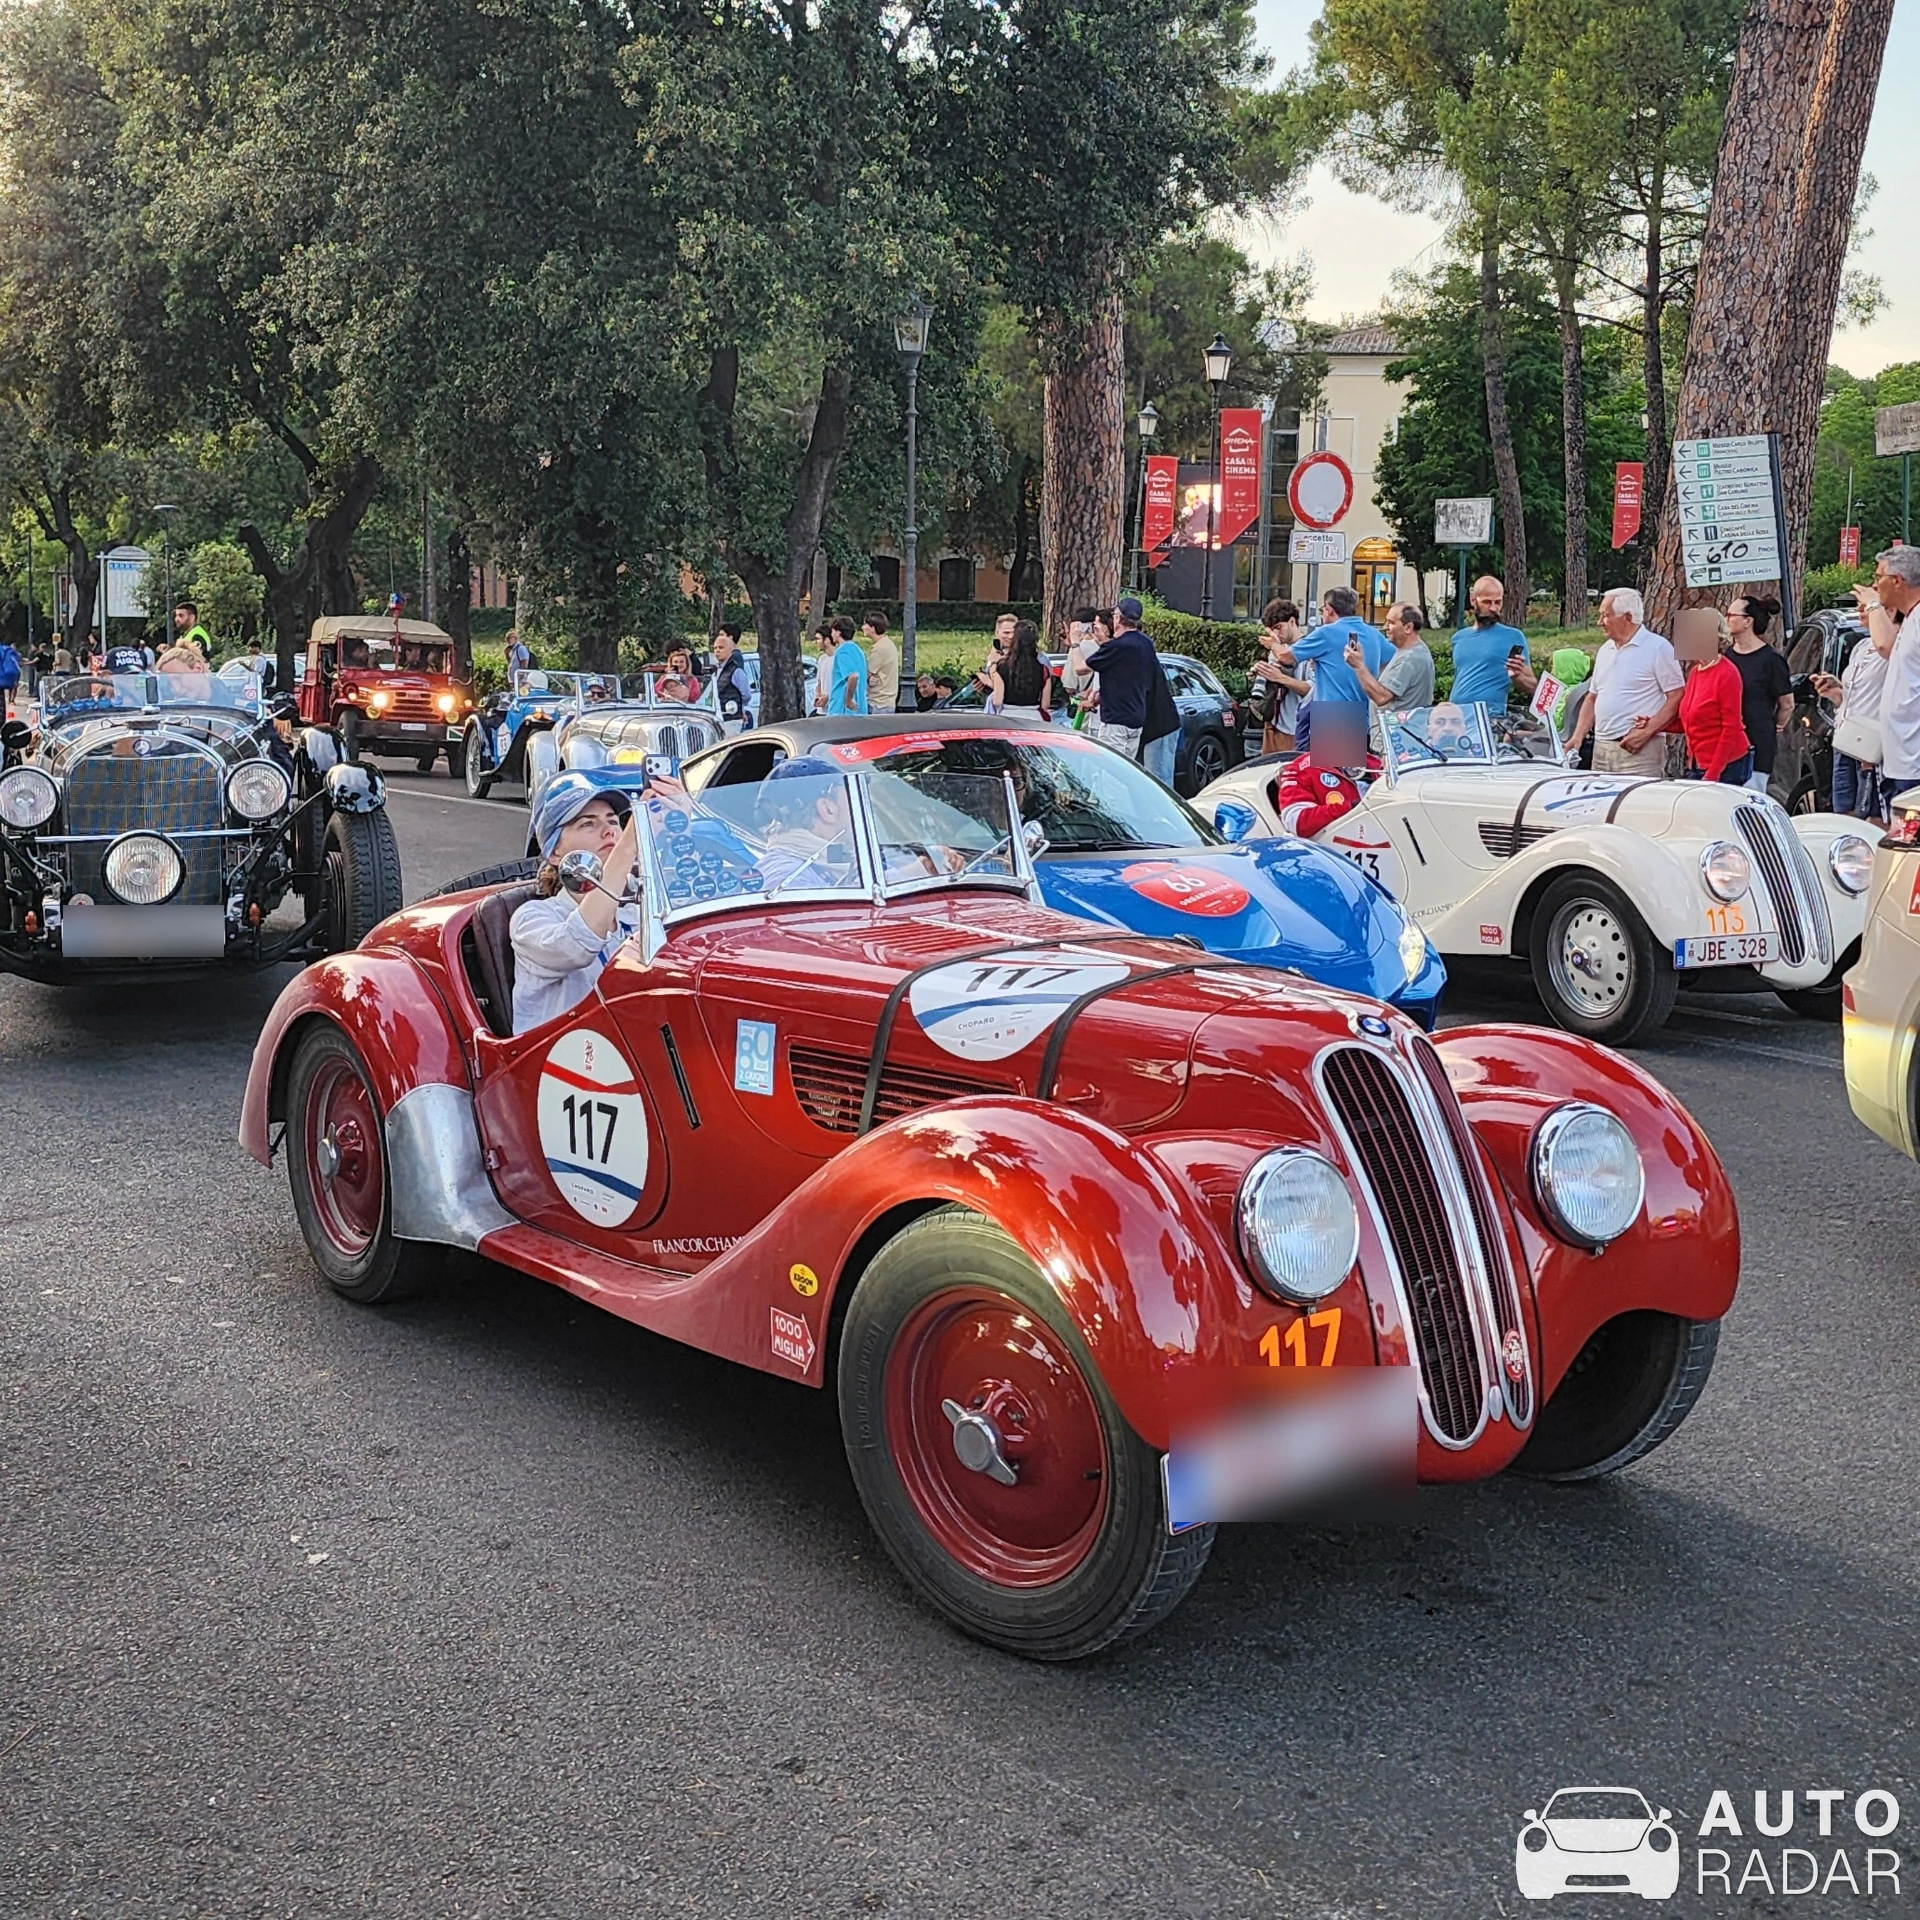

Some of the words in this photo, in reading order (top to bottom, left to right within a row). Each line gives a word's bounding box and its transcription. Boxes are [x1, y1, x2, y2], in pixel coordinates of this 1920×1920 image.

[1225, 457, 1246, 465] CASA
[1225, 466, 1256, 474] CINEMA
[115, 651, 140, 659] 1000
[1538, 681, 1550, 704] 1000
[1162, 873, 1206, 893] 66
[1482, 926, 1498, 935] 1000
[1706, 906, 1744, 934] 113
[966, 966, 1083, 992] 117
[957, 1016, 995, 1030] CHOPARD
[562, 1094, 618, 1165] 117
[798, 1283, 808, 1294] OIL
[775, 1315, 802, 1340] 1000
[1259, 1307, 1342, 1367] 117
[775, 1335, 804, 1362] MIGLIA
